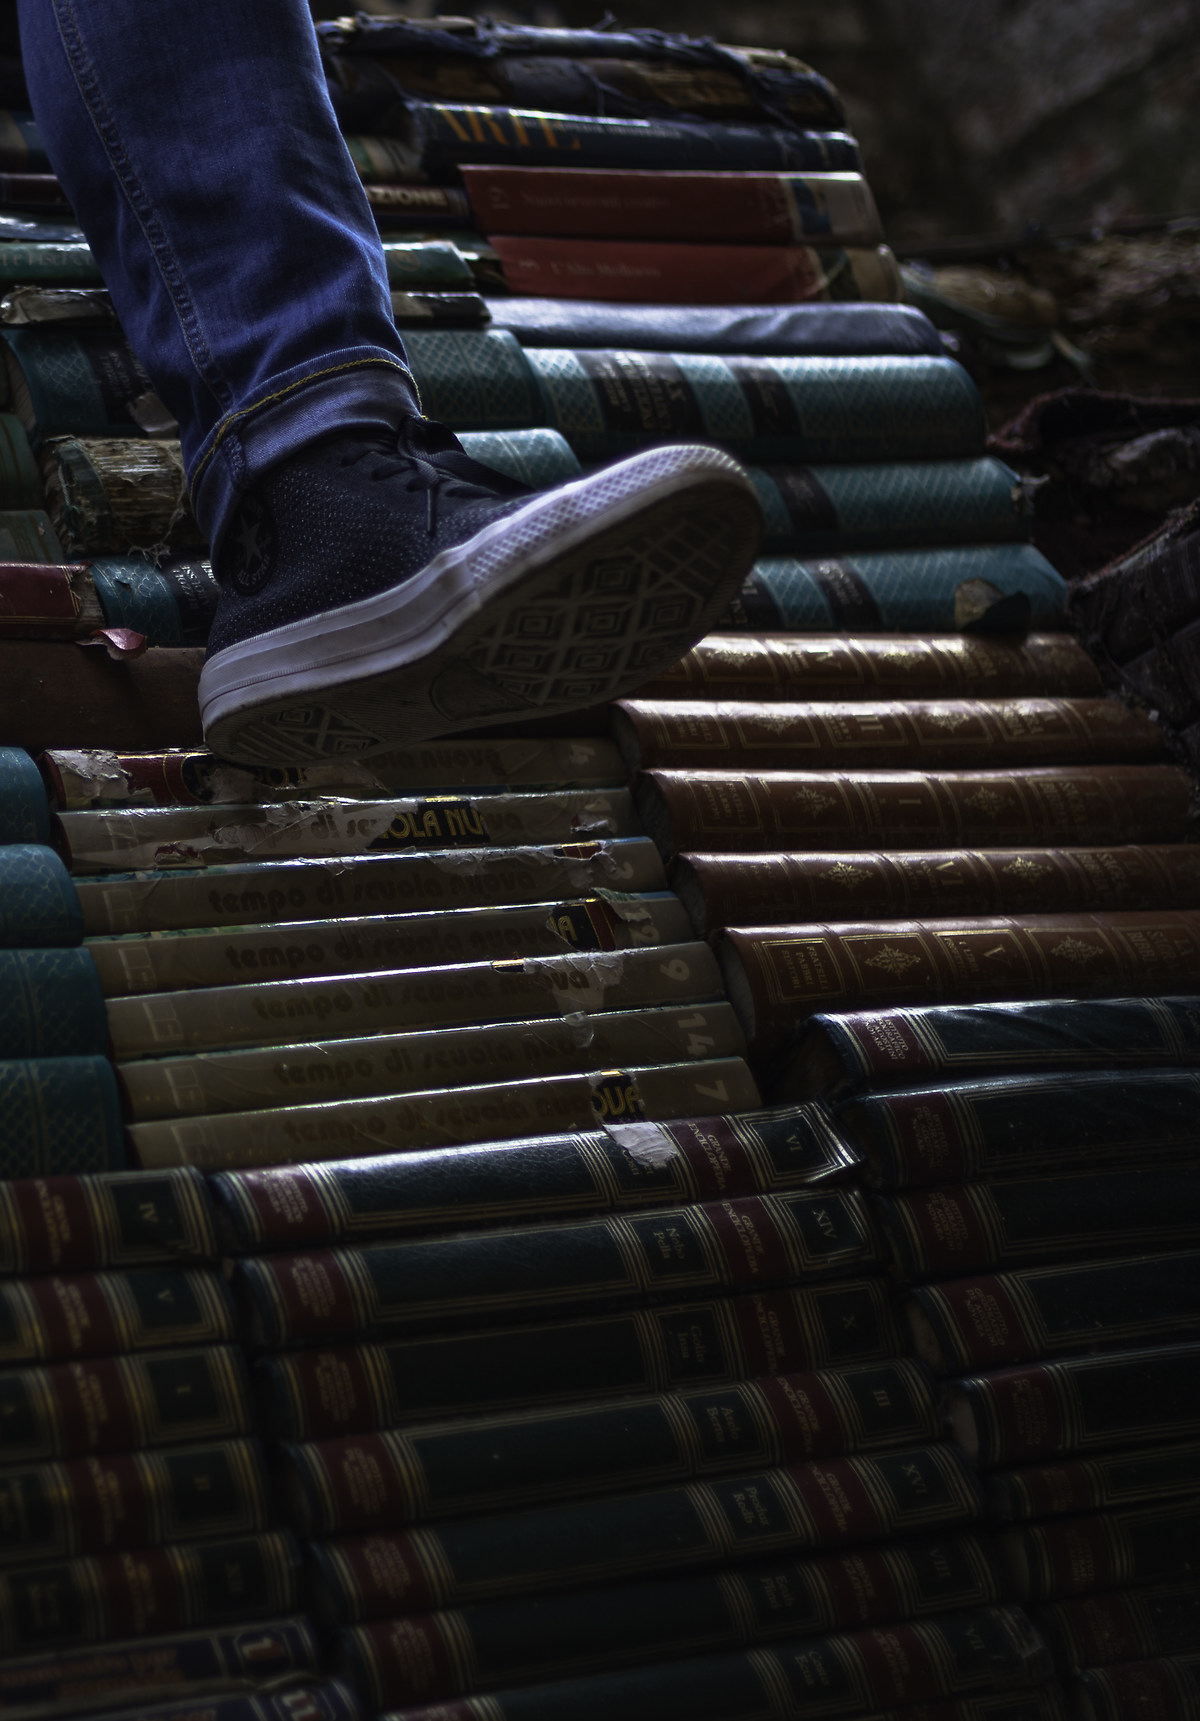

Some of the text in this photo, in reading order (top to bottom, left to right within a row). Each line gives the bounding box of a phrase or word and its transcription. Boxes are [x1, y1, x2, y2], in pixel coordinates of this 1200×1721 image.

[208, 887, 306, 916] tempo
[315, 873, 345, 909] di
[353, 871, 443, 903] scuola
[450, 870, 537, 898] nuova
[225, 943, 326, 971] tempo
[780, 949, 801, 991] EDITORI
[795, 950, 814, 986] FABBRI
[805, 945, 829, 991] FRATELLI
[252, 992, 353, 1021] tempo
[363, 983, 393, 1008] di
[403, 976, 495, 1004] scuola
[272, 1058, 374, 1087] tempo
[384, 1048, 414, 1075] di
[521, 1035, 612, 1061] nuoa
[677, 1012, 717, 1056] 14
[694, 1078, 731, 1103] 7
[687, 1122, 729, 1192] ENCICLOPEDIA
[706, 1133, 733, 1174] GRANDE
[784, 1132, 805, 1154] VI
[721, 1199, 758, 1275] ENCICLOPEDIA
[739, 1215, 769, 1257] GRANDE
[809, 1207, 838, 1240] XIV
[767, 1309, 786, 1358] GRANDE
[775, 1375, 815, 1452] ENCICLOPEDIA
[795, 1388, 823, 1433] GRANDE
[871, 1388, 892, 1408] III
[824, 1471, 854, 1514] GRANDE
[901, 1462, 929, 1496] XVI
